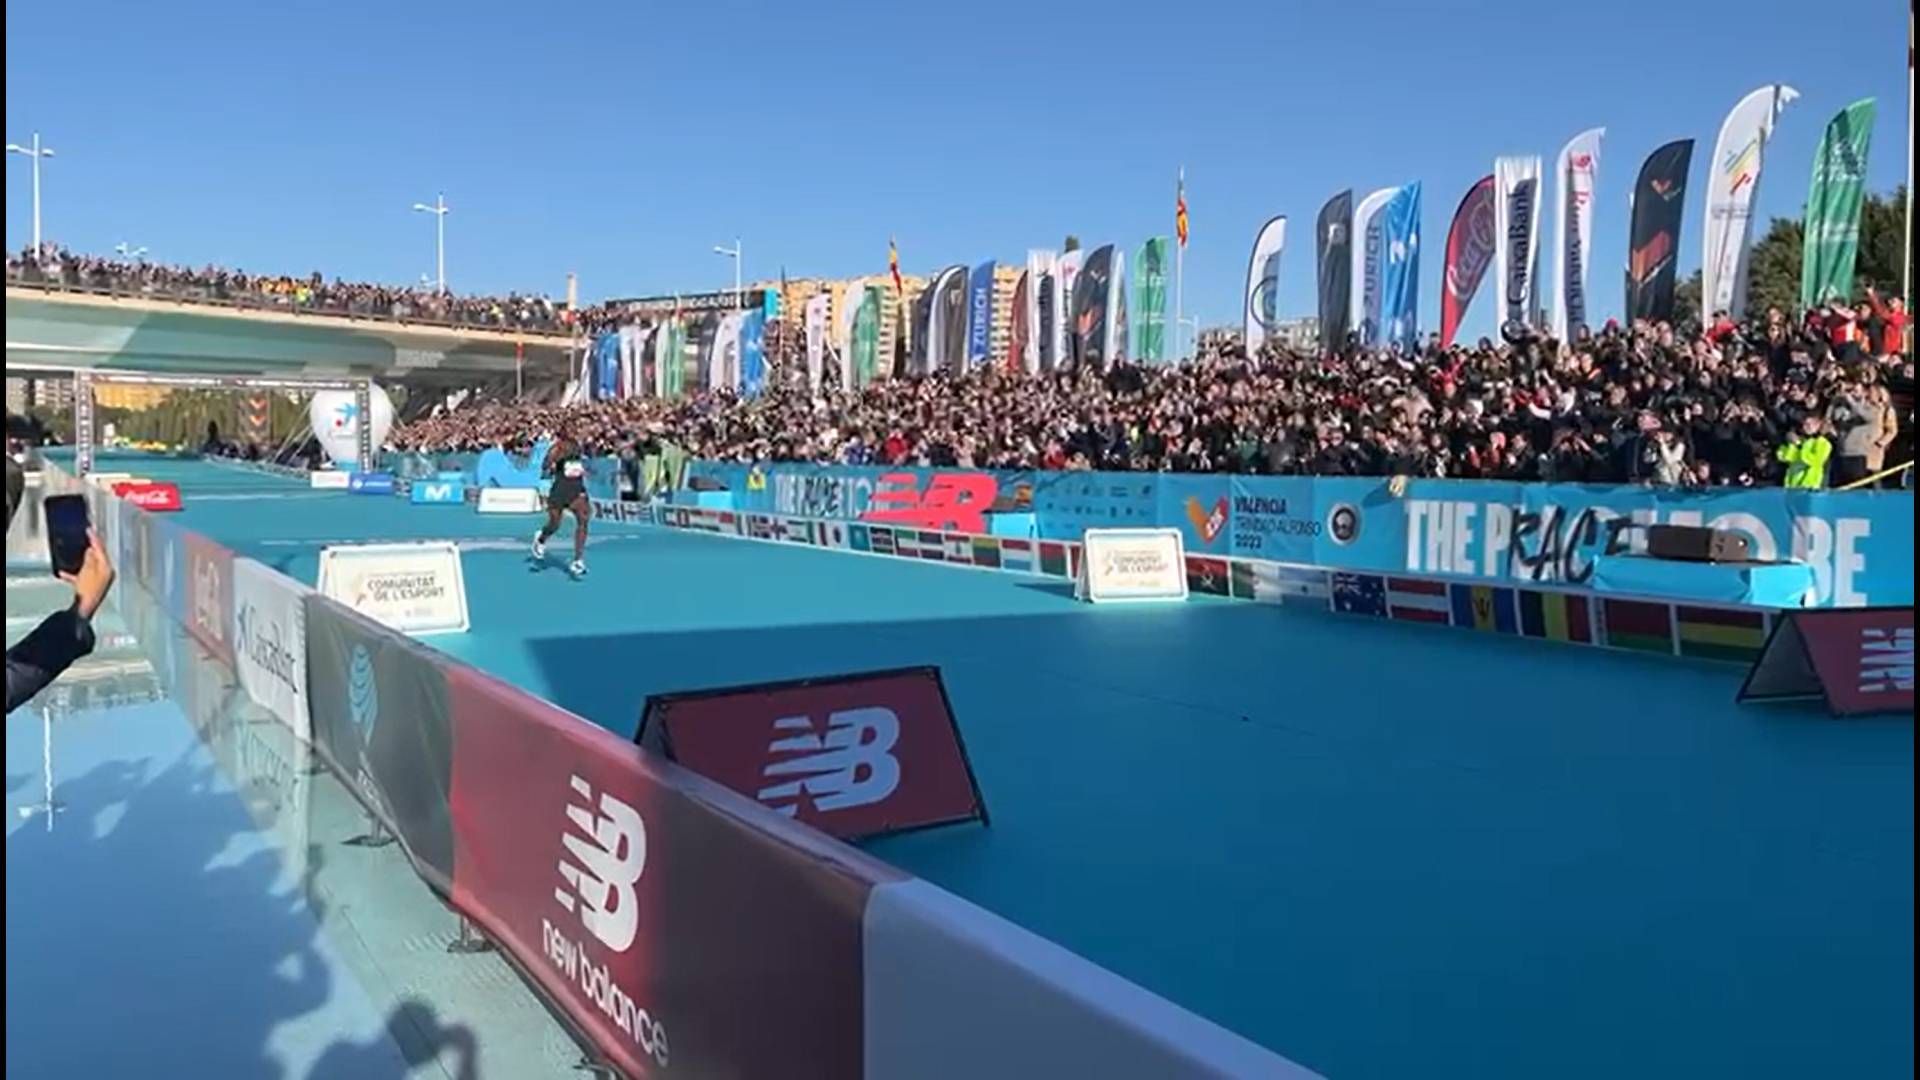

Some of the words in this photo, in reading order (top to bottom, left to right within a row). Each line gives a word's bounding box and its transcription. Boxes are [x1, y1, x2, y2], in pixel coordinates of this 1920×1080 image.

[1507, 183, 1529, 305] CaixaBank
[367, 576, 435, 591] COMUNITAT
[1406, 500, 1477, 574] THE
[542, 918, 578, 981] new
[578, 941, 670, 1067] balance
